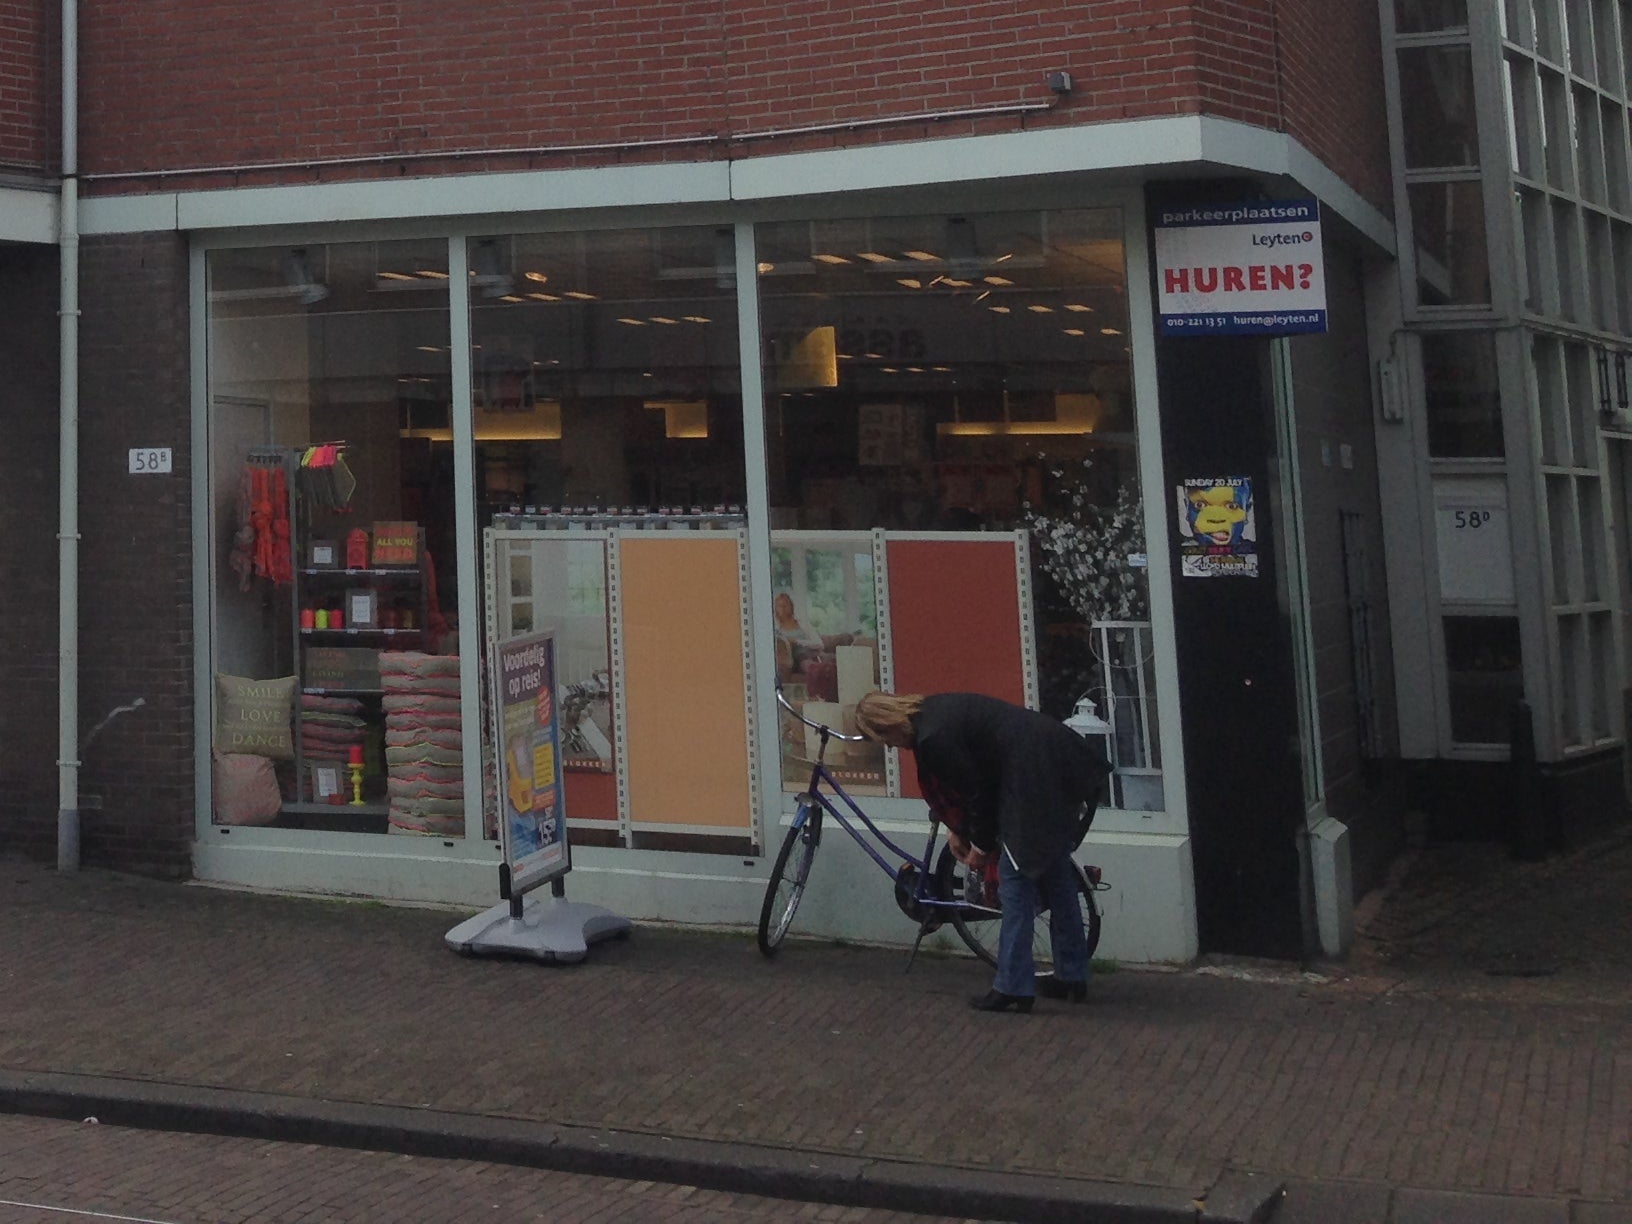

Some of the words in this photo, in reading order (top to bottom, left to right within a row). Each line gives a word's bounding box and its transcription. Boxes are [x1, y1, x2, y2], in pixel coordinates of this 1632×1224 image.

[1163, 207, 1309, 224] parkeerplaatsen
[1252, 233, 1301, 248] Leyten
[1164, 264, 1313, 294] HUREN?
[1233, 313, 1319, 327] huren@leyten.nl
[135, 451, 167, 471] 58B
[1184, 478, 1214, 487] SUNDAY
[1215, 478, 1226, 487] 20
[1227, 478, 1243, 487] JULY
[1455, 510, 1491, 529] 58D
[502, 644, 546, 673] Voordelig
[508, 677, 521, 698] op
[521, 668, 542, 692] reis!
[238, 684, 283, 699] SMILE
[240, 707, 281, 723] LOVE
[231, 732, 287, 748] DANCE
